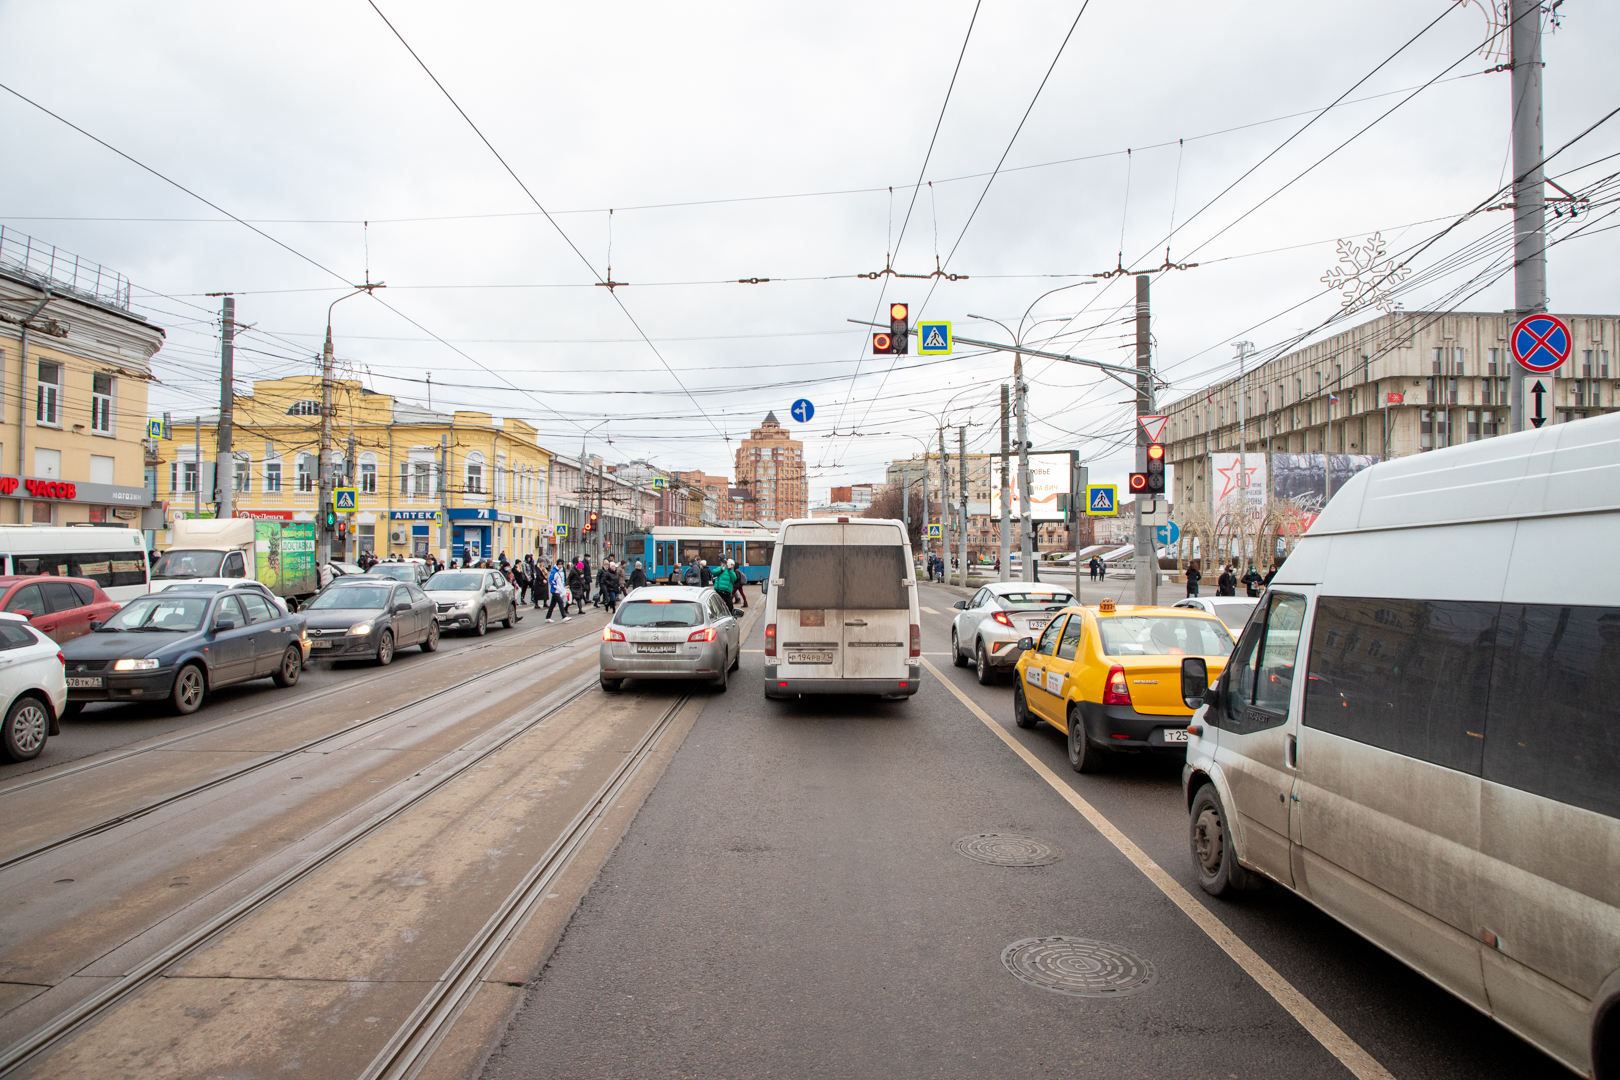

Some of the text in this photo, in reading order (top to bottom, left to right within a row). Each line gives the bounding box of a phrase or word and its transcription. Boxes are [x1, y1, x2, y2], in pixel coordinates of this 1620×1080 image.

[25, 479, 76, 499] ЧАСОВ
[112, 492, 142, 500] магазин
[282, 542, 312, 550] ДОСТАВКА
